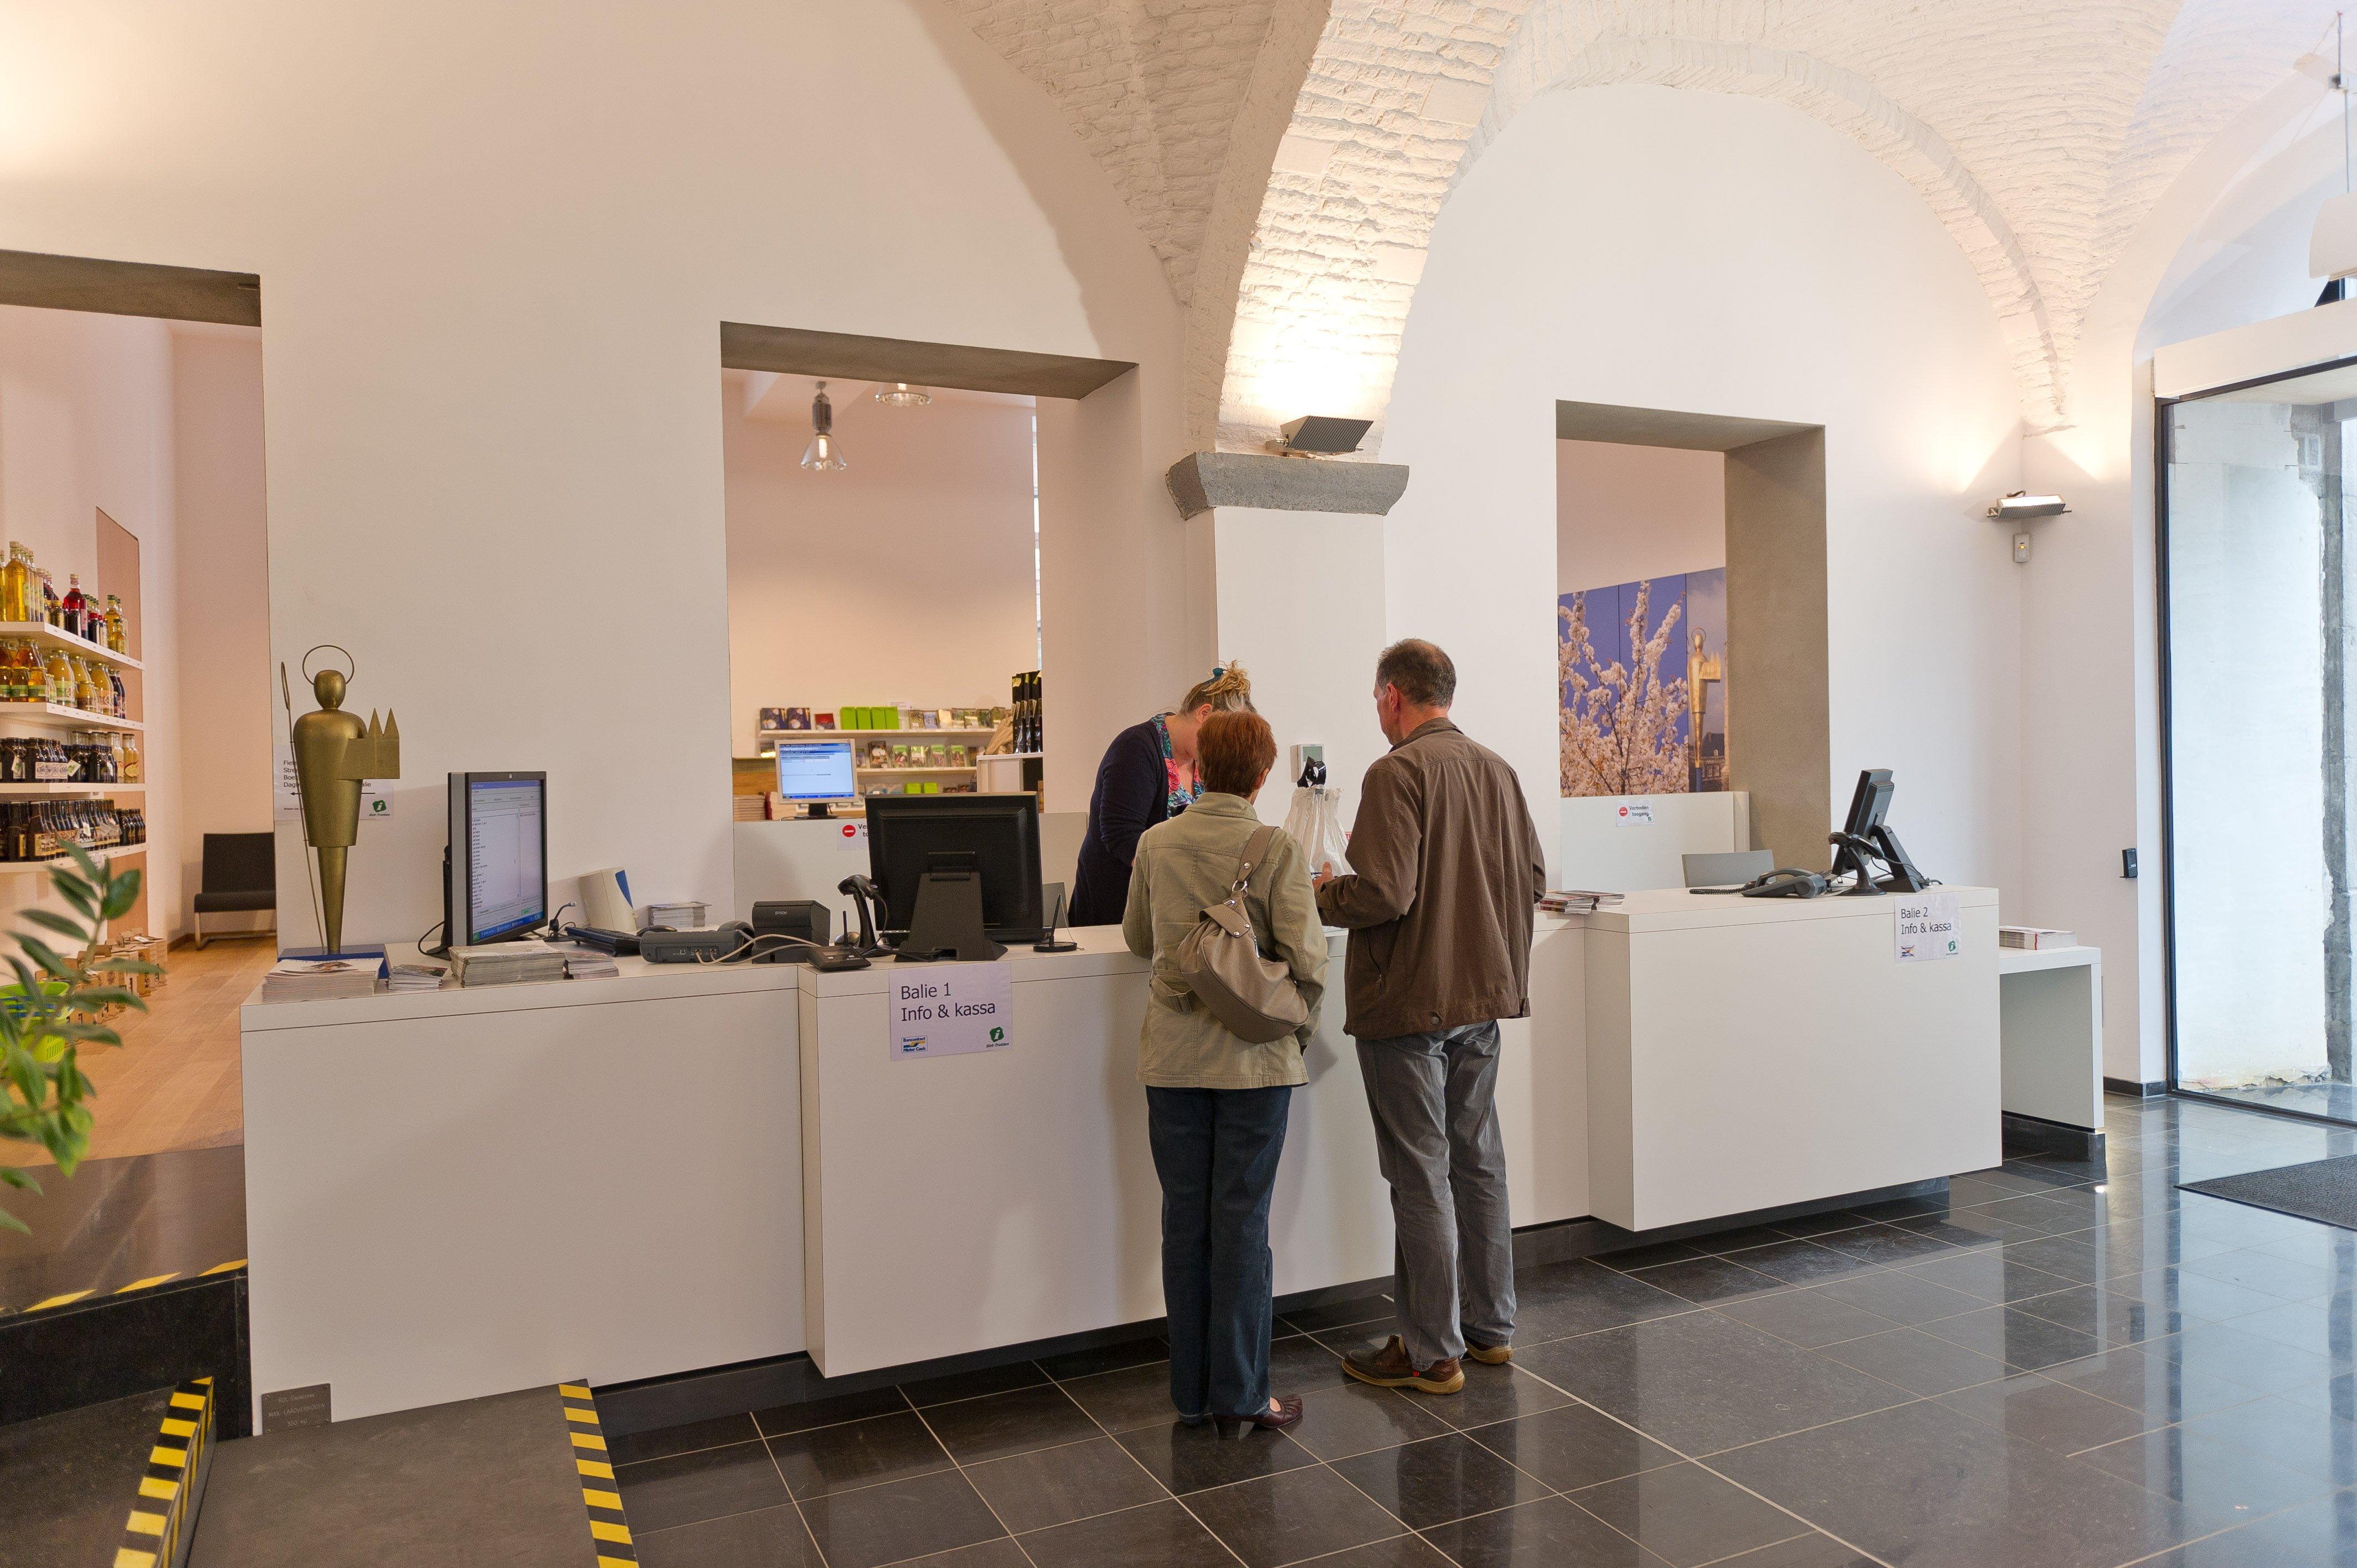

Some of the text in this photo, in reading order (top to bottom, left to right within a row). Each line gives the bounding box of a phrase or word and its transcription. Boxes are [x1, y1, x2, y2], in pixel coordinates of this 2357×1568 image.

[1901, 907, 1928, 919] Balie 2
[1901, 922, 1952, 935] Info & kassa
[901, 982, 951, 1000] Balie 1
[901, 1003, 995, 1022] Info & kassa
